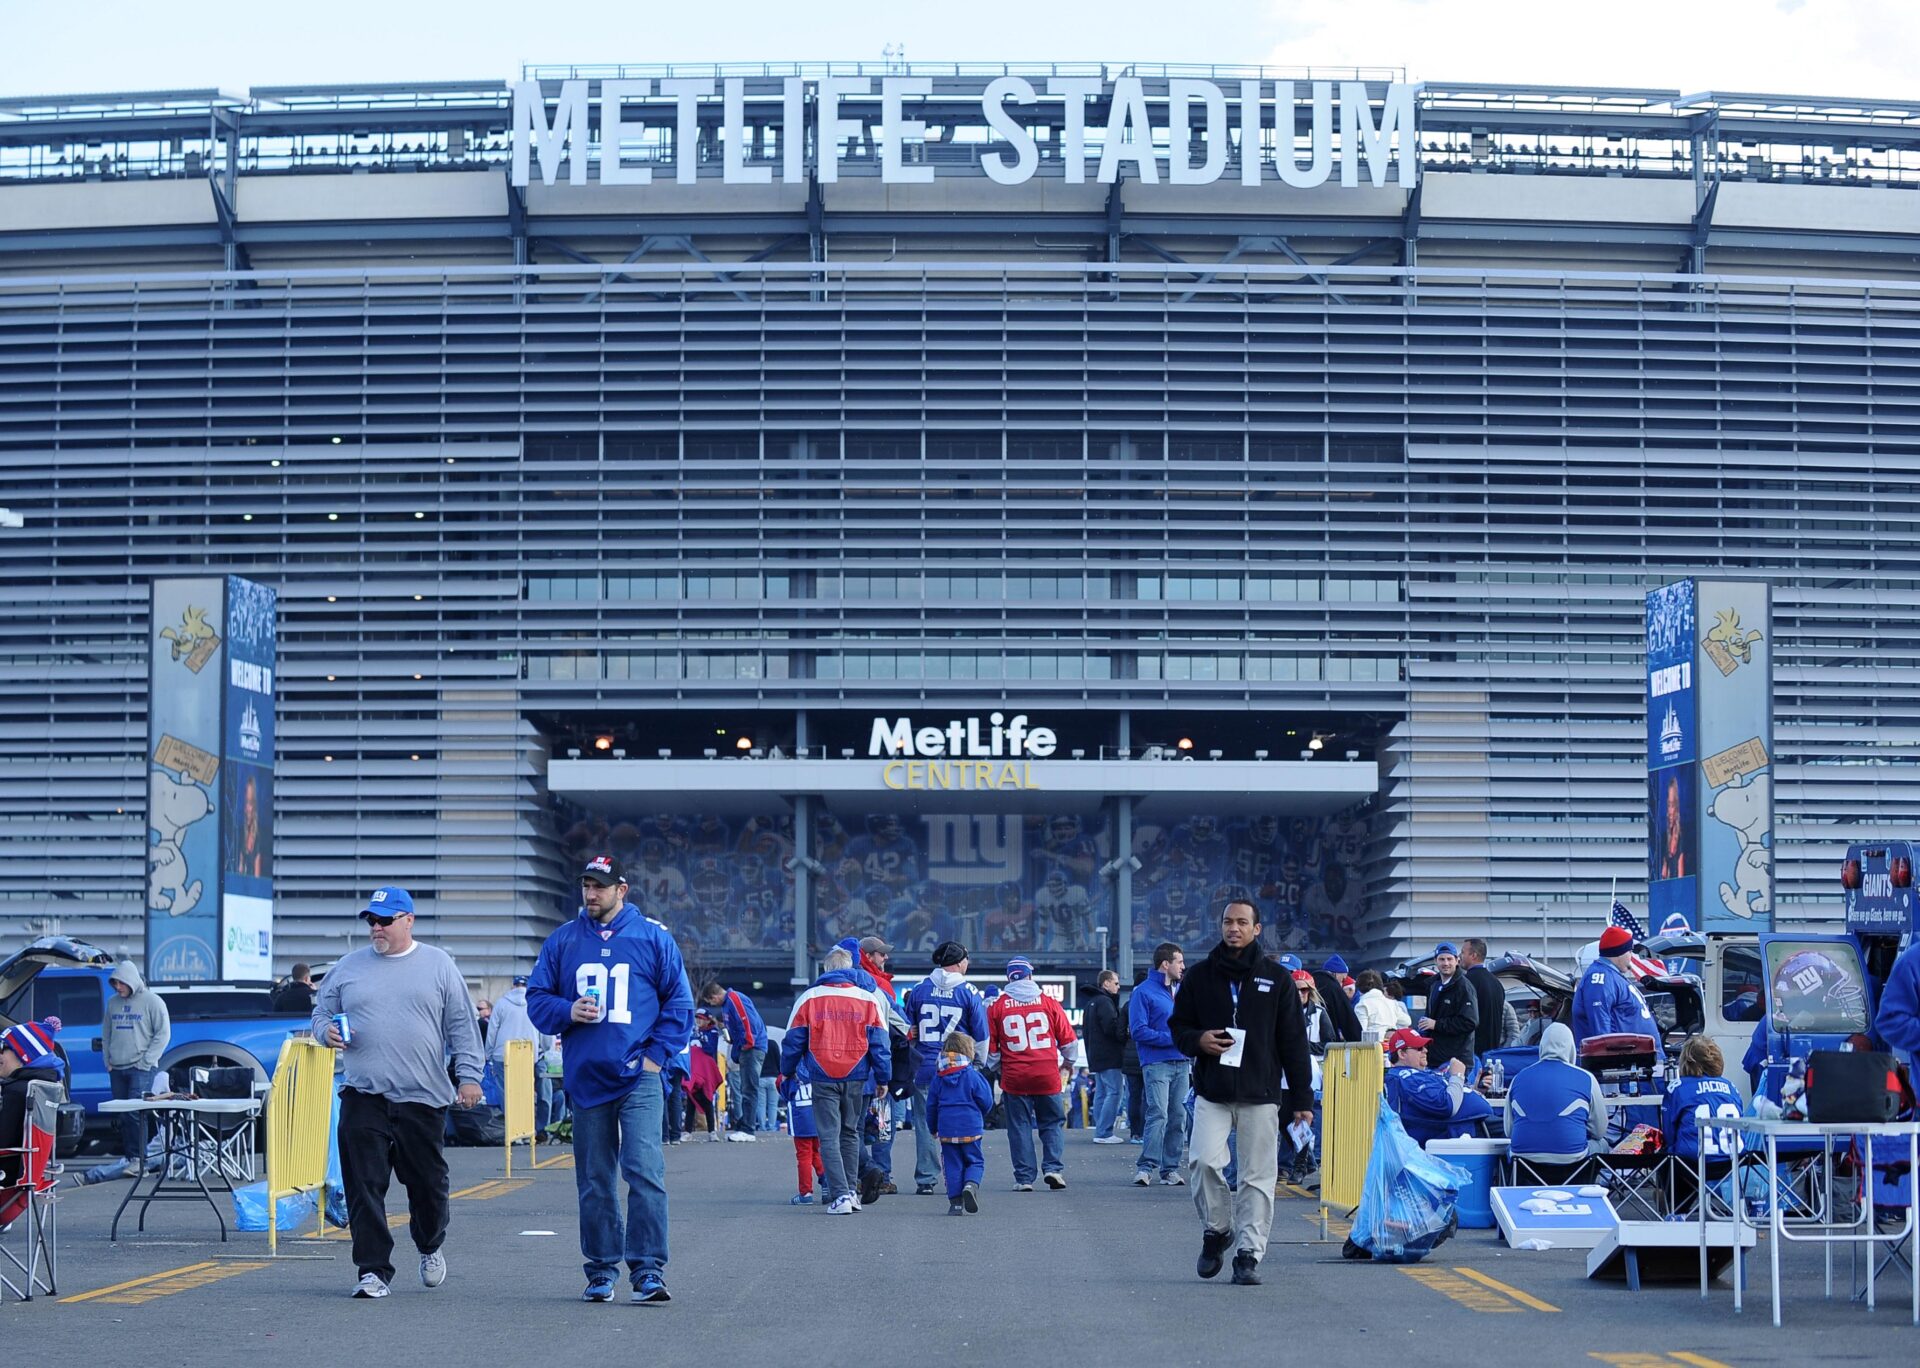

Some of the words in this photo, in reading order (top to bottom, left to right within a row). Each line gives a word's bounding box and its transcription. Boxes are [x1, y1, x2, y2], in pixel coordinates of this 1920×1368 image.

[512, 77, 935, 186] METLIFE
[980, 76, 1417, 188] STADIUM
[230, 658, 262, 693] WELCOME
[262, 666, 272, 695] TO
[1650, 664, 1681, 698] WELCOME
[1681, 661, 1691, 690] TO
[868, 711, 1057, 757] MetLife
[883, 760, 1041, 790] CENTRAL
[864, 851, 900, 876] 42
[1863, 873, 1893, 898] GIANTS
[575, 962, 632, 1024] 91
[1591, 972, 1605, 985] 91
[919, 1004, 963, 1042] 27
[1003, 1011, 1052, 1052] 92
